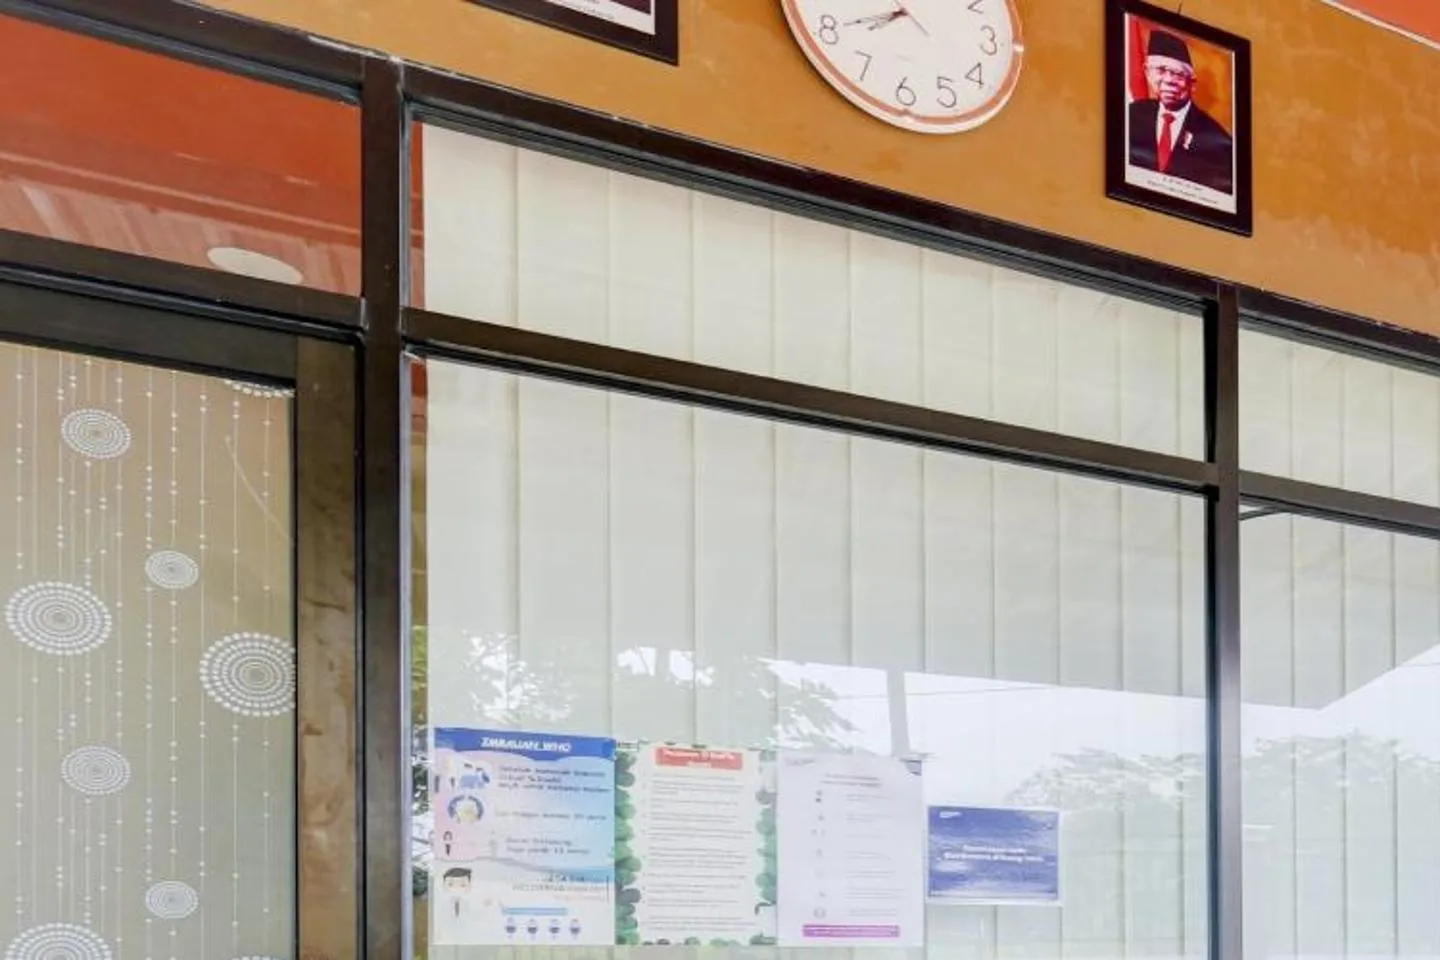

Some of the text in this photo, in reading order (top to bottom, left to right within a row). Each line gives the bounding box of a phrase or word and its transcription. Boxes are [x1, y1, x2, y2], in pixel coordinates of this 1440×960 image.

[818, 14, 839, 45] 8
[980, 25, 998, 56] 3
[855, 50, 872, 81] 7
[965, 62, 984, 89] 4
[895, 76, 917, 106] 6
[936, 75, 957, 108] 5
